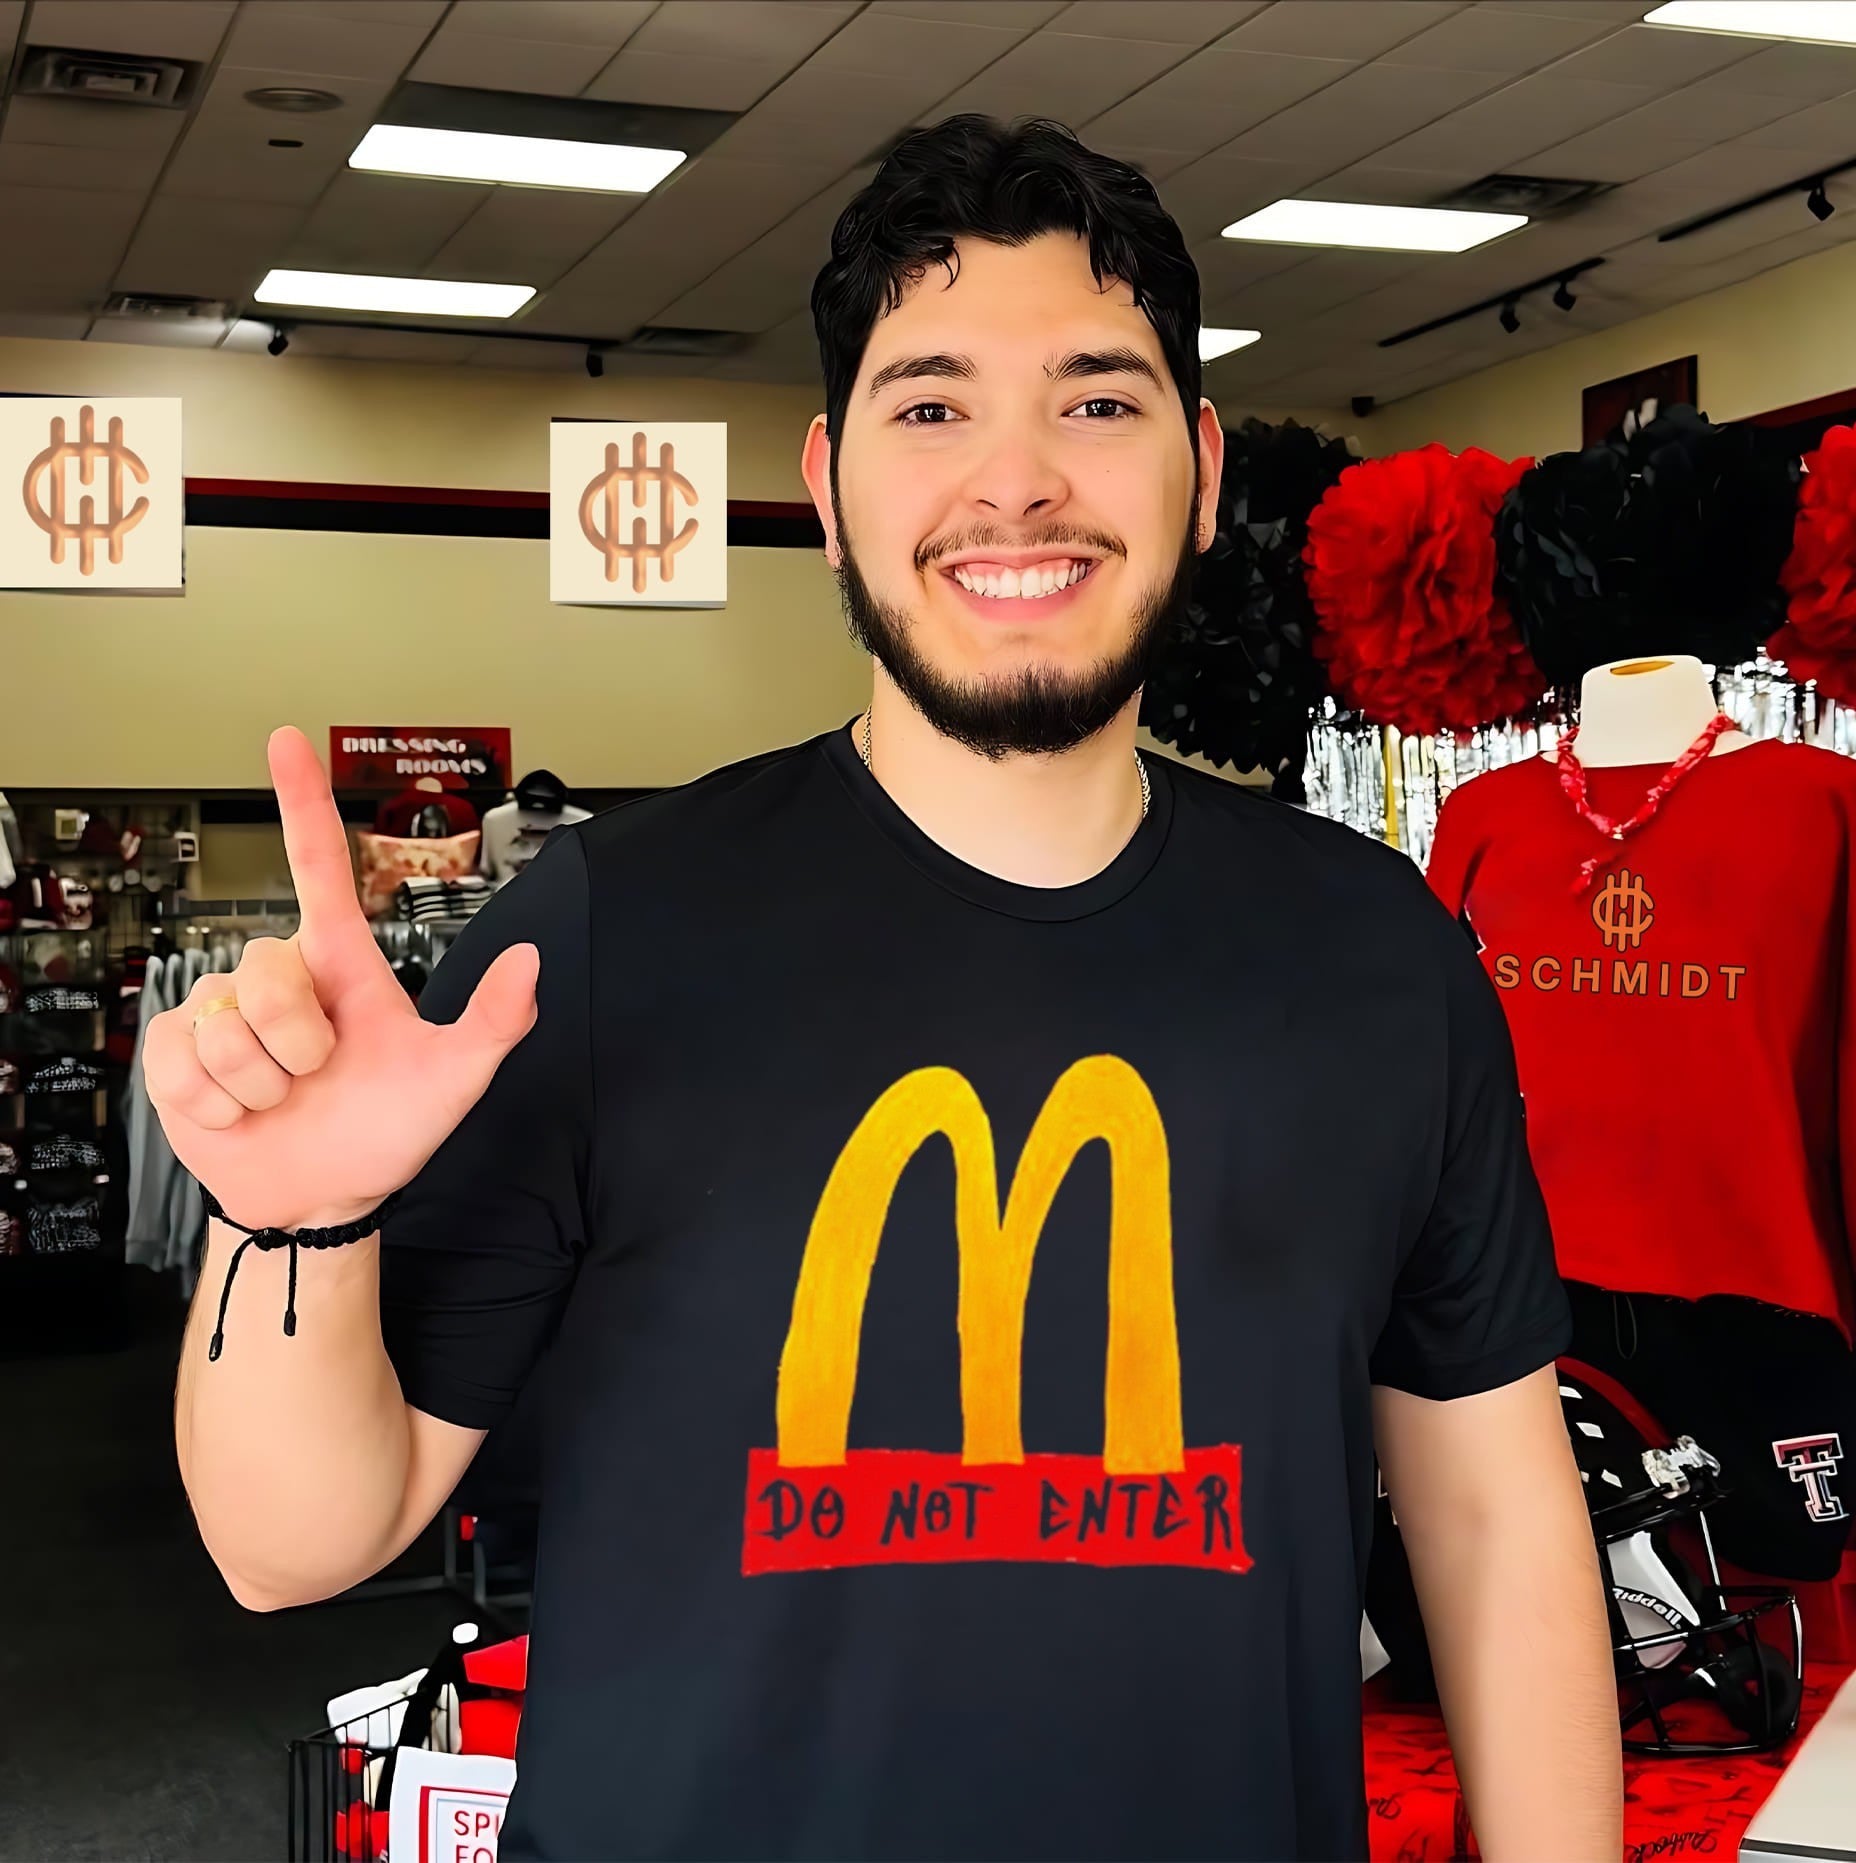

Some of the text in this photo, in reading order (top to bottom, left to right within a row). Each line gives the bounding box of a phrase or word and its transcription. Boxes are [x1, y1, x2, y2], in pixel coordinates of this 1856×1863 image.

[342, 737, 467, 754] DRESSING
[396, 758, 487, 775] ROOMS
[1493, 952, 1746, 1000] SCHMIDT
[756, 1474, 1234, 1555] DO NOT ENTER
[1612, 1588, 1682, 1626] Riddell
